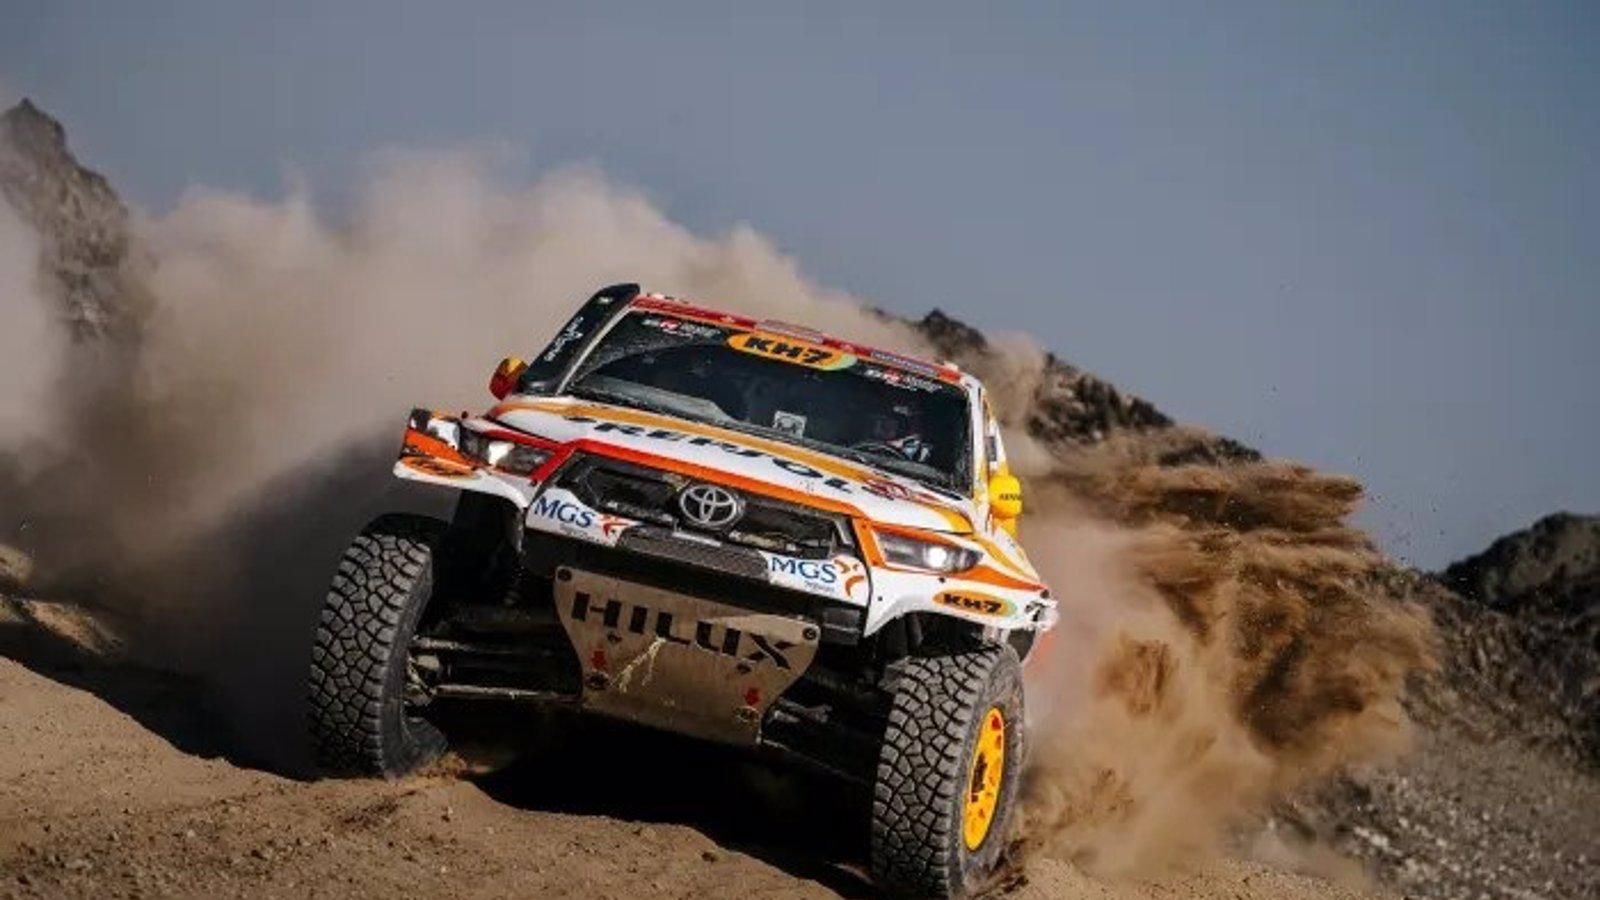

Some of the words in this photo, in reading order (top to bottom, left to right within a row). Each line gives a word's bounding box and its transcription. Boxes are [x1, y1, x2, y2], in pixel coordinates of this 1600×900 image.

[742, 336, 832, 363] KH7
[533, 495, 596, 528] MGS
[770, 556, 838, 583] MGS
[943, 592, 1001, 613] KH7
[571, 591, 796, 670] HILUX
